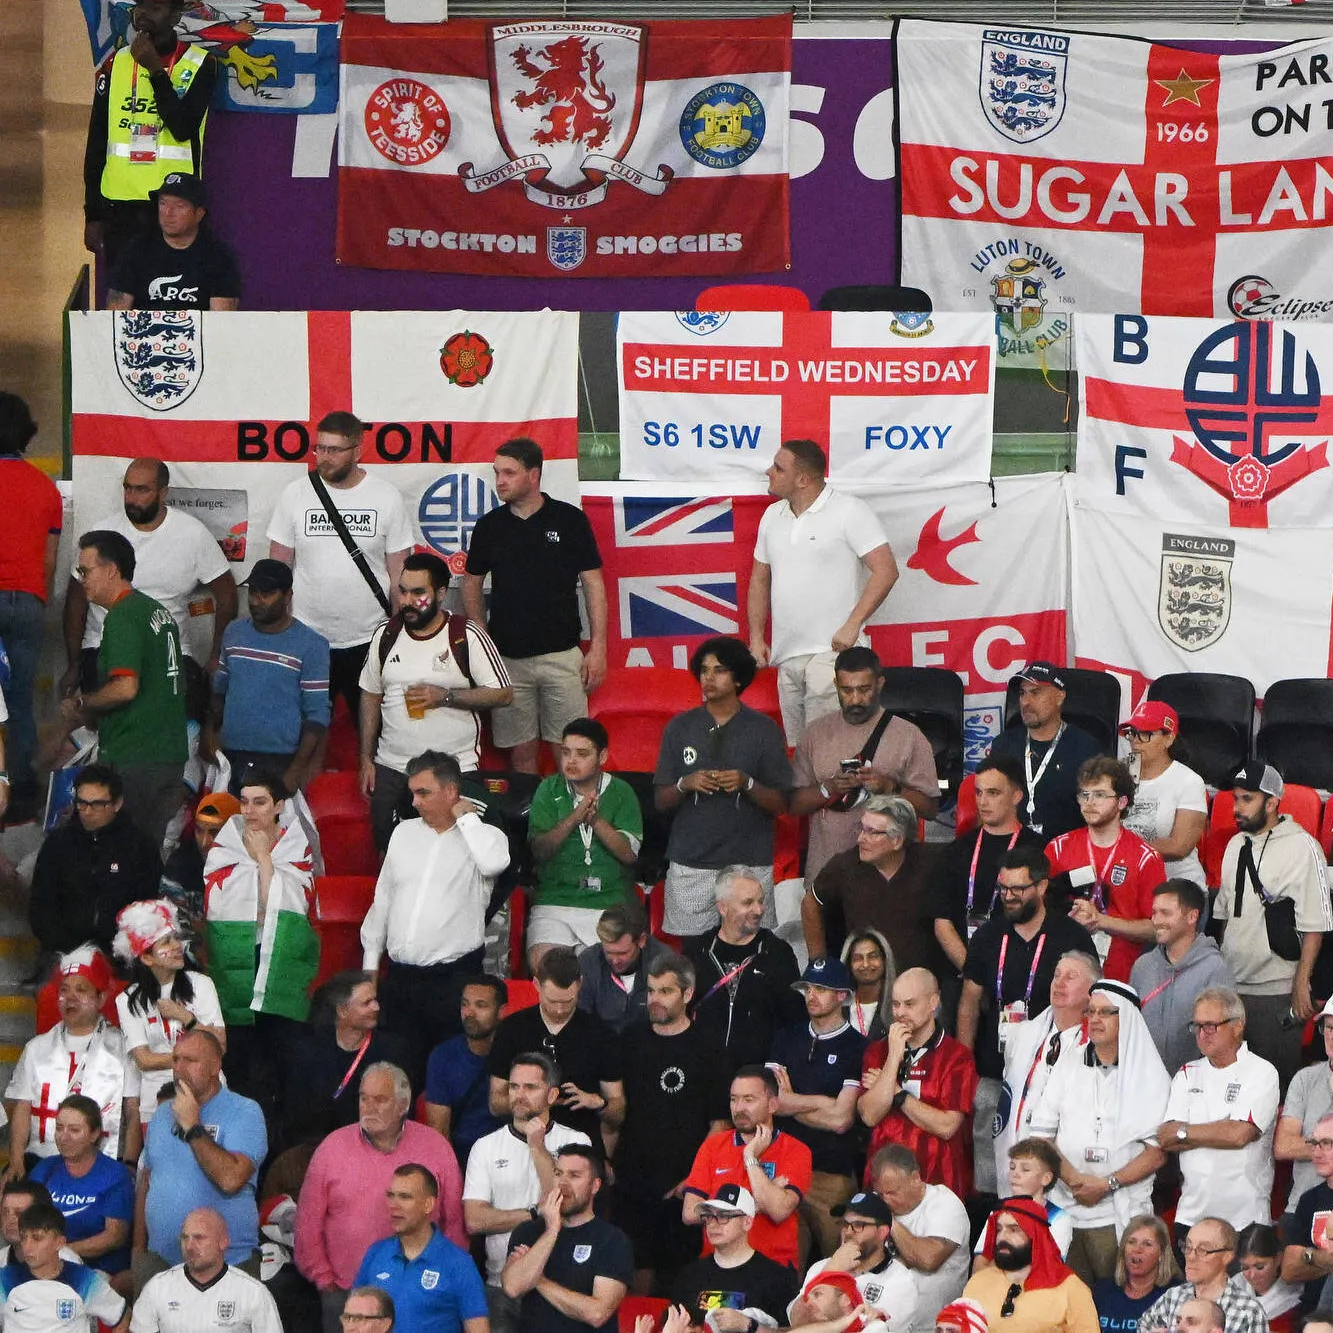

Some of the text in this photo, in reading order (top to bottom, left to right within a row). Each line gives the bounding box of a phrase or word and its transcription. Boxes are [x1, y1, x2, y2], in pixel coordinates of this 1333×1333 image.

[497, 22, 638, 37] MIDDLESBROUGH
[986, 30, 1066, 51] ENGLAND
[374, 83, 443, 114] SPIRIT OF
[1156, 122, 1209, 144] 1966
[1251, 103, 1311, 137] ON
[370, 125, 446, 162] TEESSIDE
[474, 155, 643, 190] FOOTBALL CLUB
[547, 194, 588, 208] 1876
[948, 156, 1196, 226] SUGAR
[387, 226, 743, 255] STOCKTON SMOGGIES
[970, 239, 1066, 280] LUTON TOWN
[1113, 314, 1149, 365] B
[634, 355, 978, 384] SHEFFIELD WEDNESDAY
[237, 422, 452, 463] BOON
[644, 421, 761, 449] S6 1SW
[866, 424, 953, 450] FOXY
[1115, 444, 1147, 496] F
[310, 513, 370, 525] BAOUR
[1170, 538, 1229, 553] ENGLAND
[52, 1191, 97, 1205] LIONS
